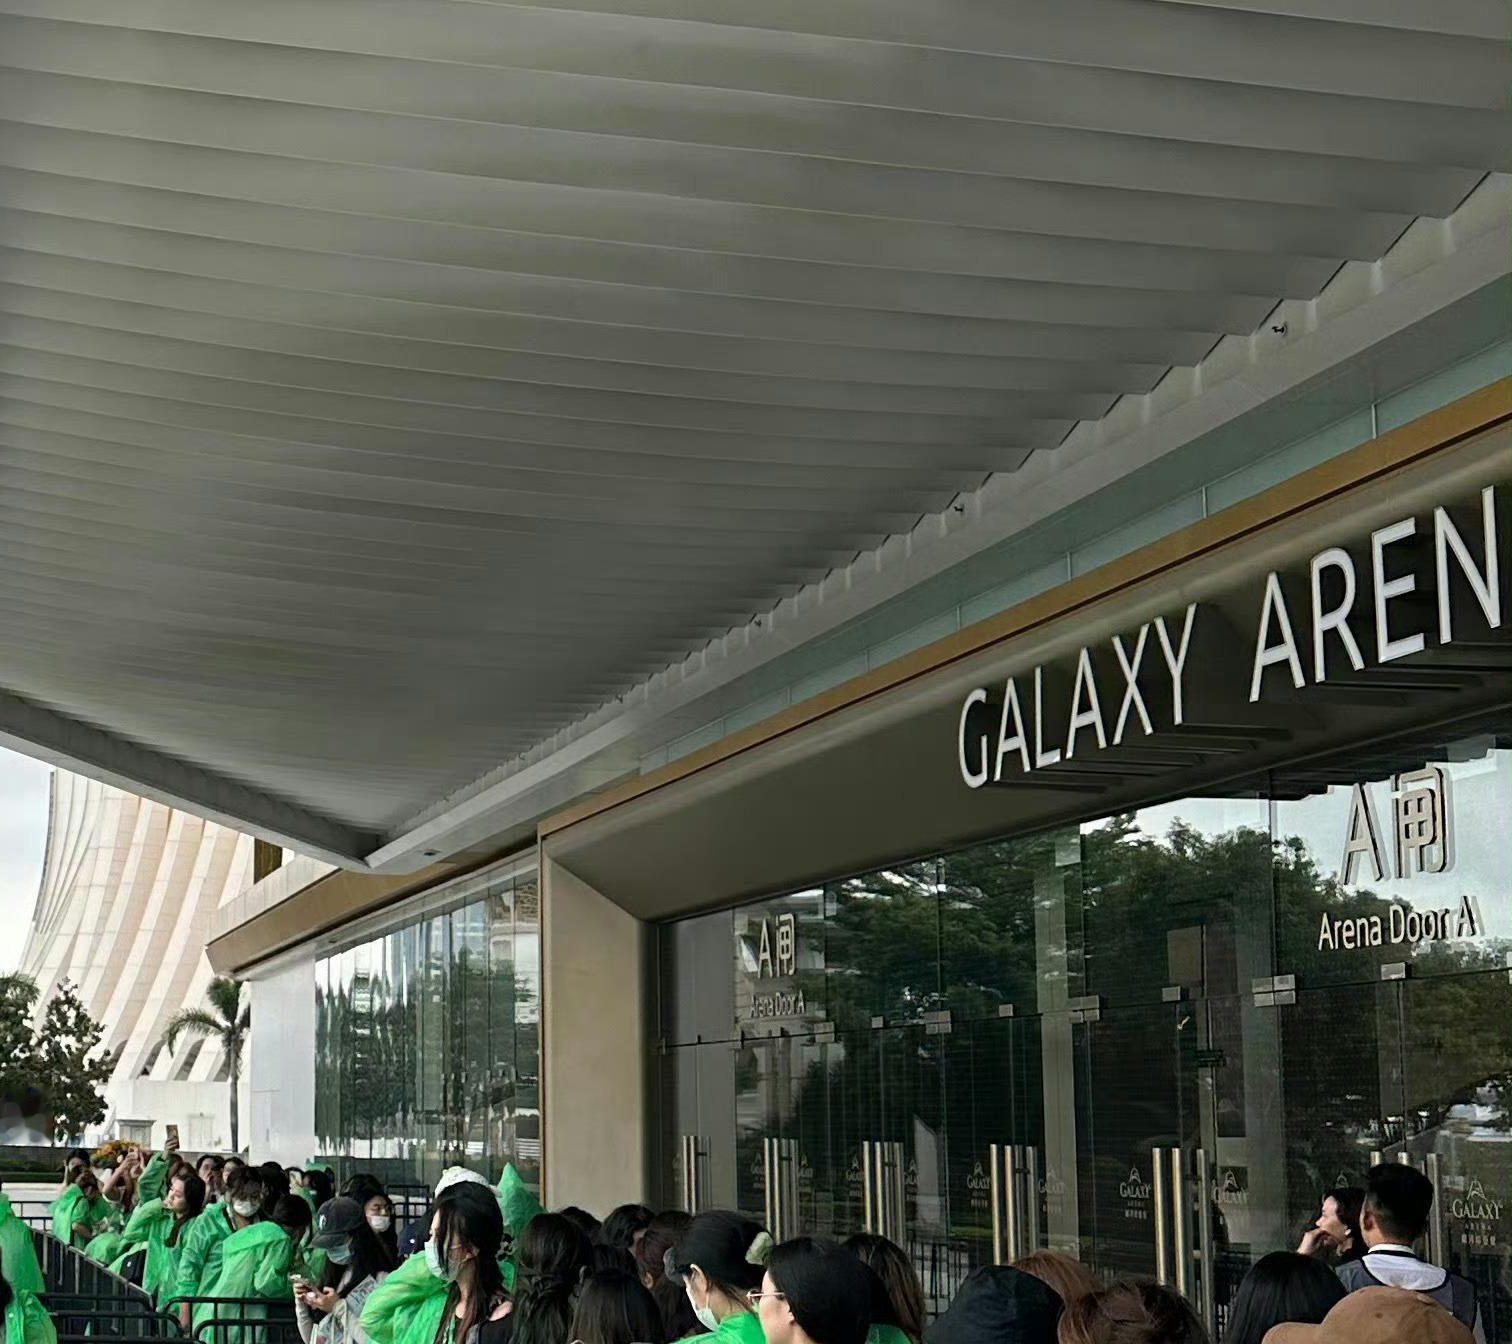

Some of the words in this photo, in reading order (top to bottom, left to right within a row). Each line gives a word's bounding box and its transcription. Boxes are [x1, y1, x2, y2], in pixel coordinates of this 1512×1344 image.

[958, 602, 1199, 789] GALAXY
[1318, 912, 1383, 951] Arena
[1390, 904, 1450, 945] Door
[1456, 895, 1478, 937] A
[750, 994, 774, 1017] Arena
[775, 991, 796, 1016] Door
[797, 989, 806, 1014] A
[1452, 1199, 1500, 1220] GALAXY
